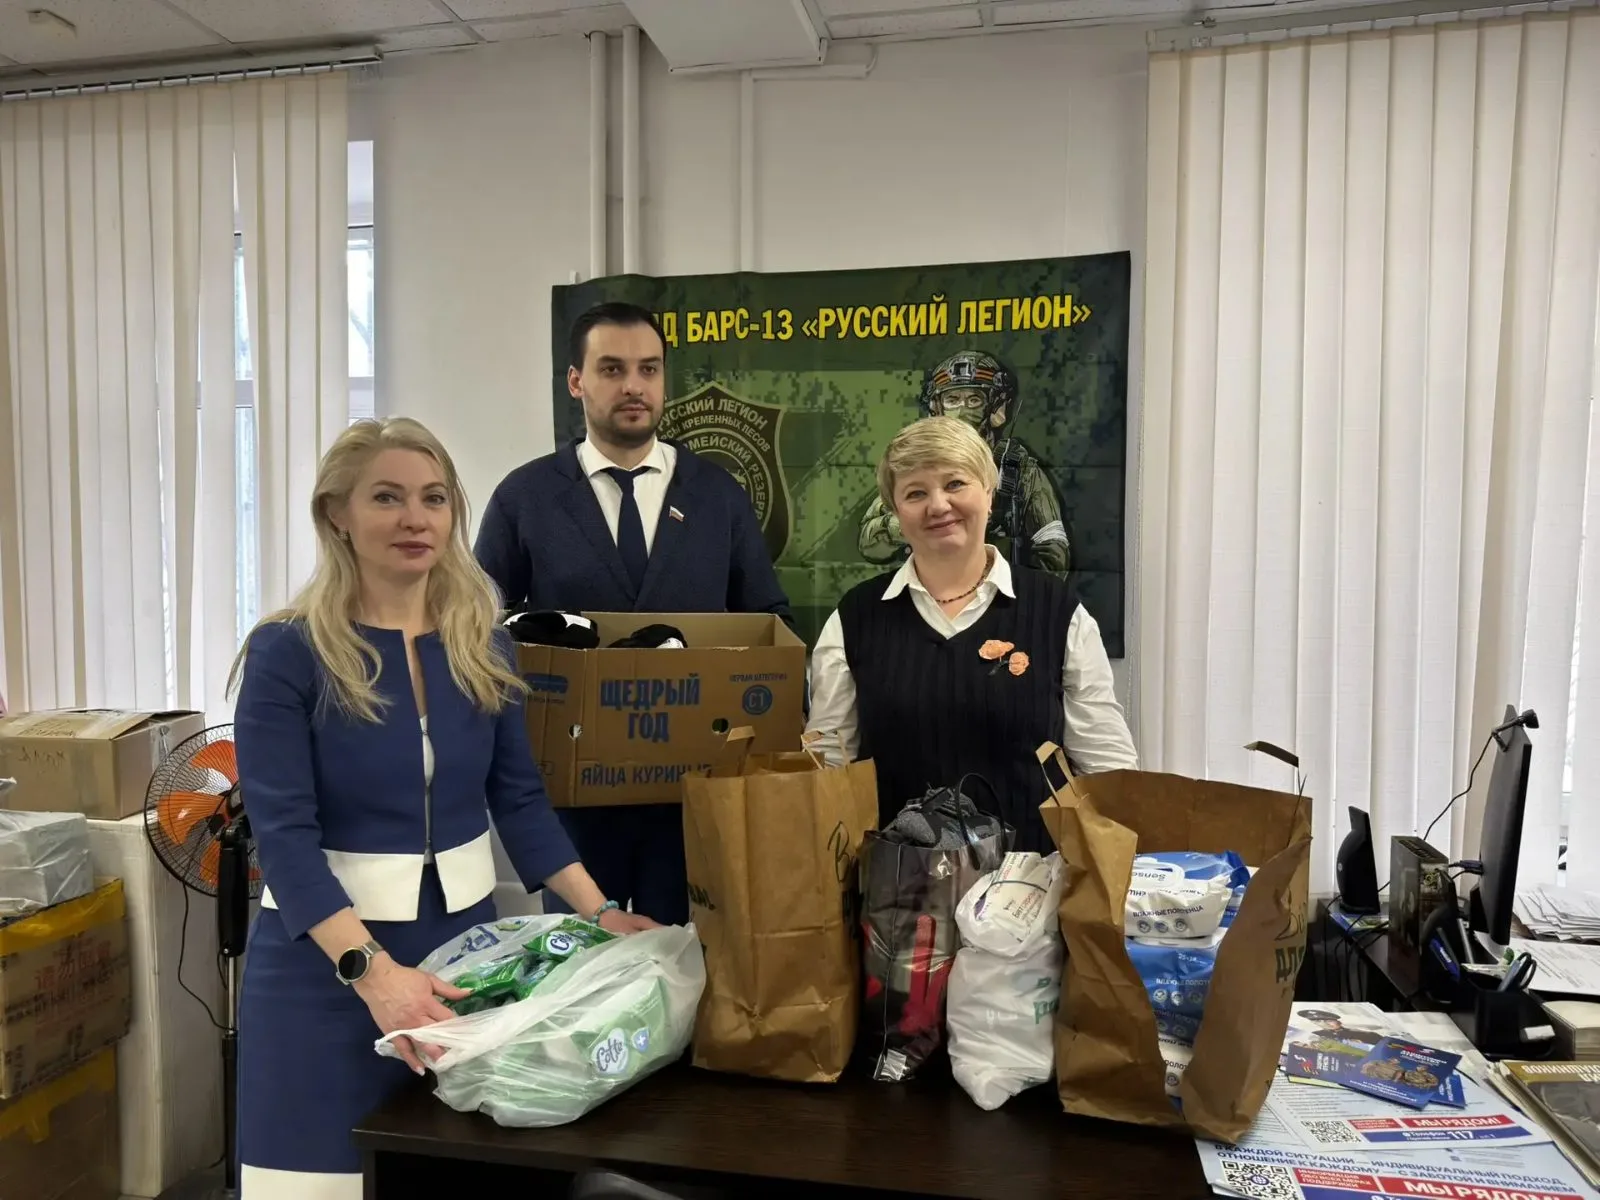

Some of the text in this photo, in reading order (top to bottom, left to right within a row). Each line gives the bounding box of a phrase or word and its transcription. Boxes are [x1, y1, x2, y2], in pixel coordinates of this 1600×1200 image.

[653, 293, 1092, 348] Д БАРС-13 «РУССКИЙ ЛЕГИОН»
[657, 396, 769, 431] РУССКИЙ ЛЕГИОН
[682, 414, 741, 431] КРЕМЕННЫХ
[741, 423, 771, 453] ЛЕСОВ
[684, 434, 753, 464] МЕЙСКИЙ
[600, 673, 700, 711] ЩЕДРЫЙ
[627, 712, 670, 744] ГОД
[581, 764, 626, 787] ЯЙЦА
[596, 1038, 624, 1072] Cotte
[1412, 1116, 1502, 1128] МЫ РЯДОМ!
[1447, 1130, 1474, 1140] 117
[1217, 1152, 1298, 1166] ОТНОШЕНИЕ
[1308, 1161, 1380, 1174] КАЖДОМУ
[1411, 1171, 1473, 1183] ЗАБОТОЙ
[1486, 1178, 1577, 1193] ВНИМАНИЕМ
[1225, 1145, 1284, 1157] КАЖДОЙ
[1285, 1151, 1355, 1164] СИТУАЦИИ
[1371, 1160, 1500, 1178] ИНДИВИДУАЛЬНЫЙ
[1403, 1181, 1455, 1196] МЫ
